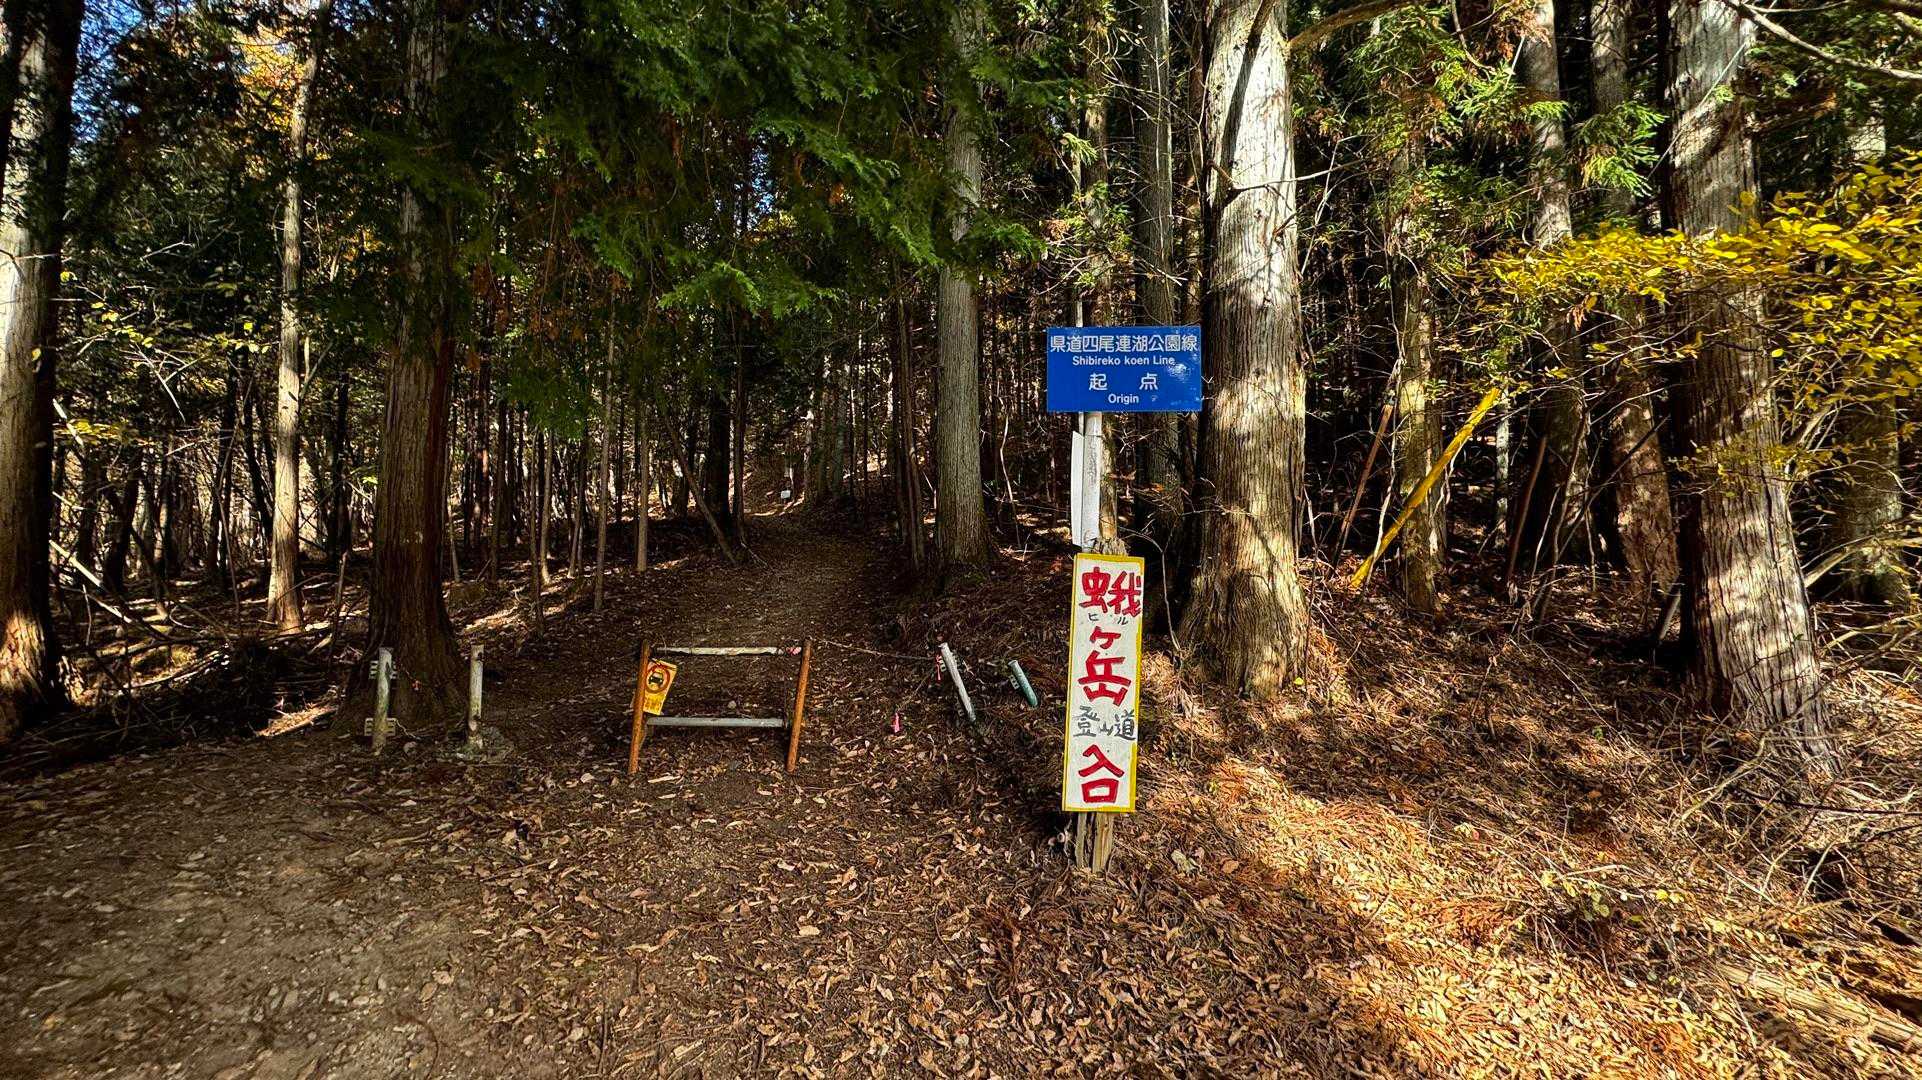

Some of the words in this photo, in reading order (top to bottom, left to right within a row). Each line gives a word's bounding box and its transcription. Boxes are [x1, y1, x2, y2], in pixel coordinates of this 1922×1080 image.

[1050, 334, 1198, 353] 県道四尾連湖公園線
[1072, 355, 1121, 366] Shibireko
[1124, 355, 1150, 366] koen
[1152, 355, 1176, 366] Line
[1088, 372, 1159, 391] 起点
[1107, 393, 1140, 405] Origin
[1073, 705, 1137, 741] 登山道
[1077, 744, 1125, 804] 入口
